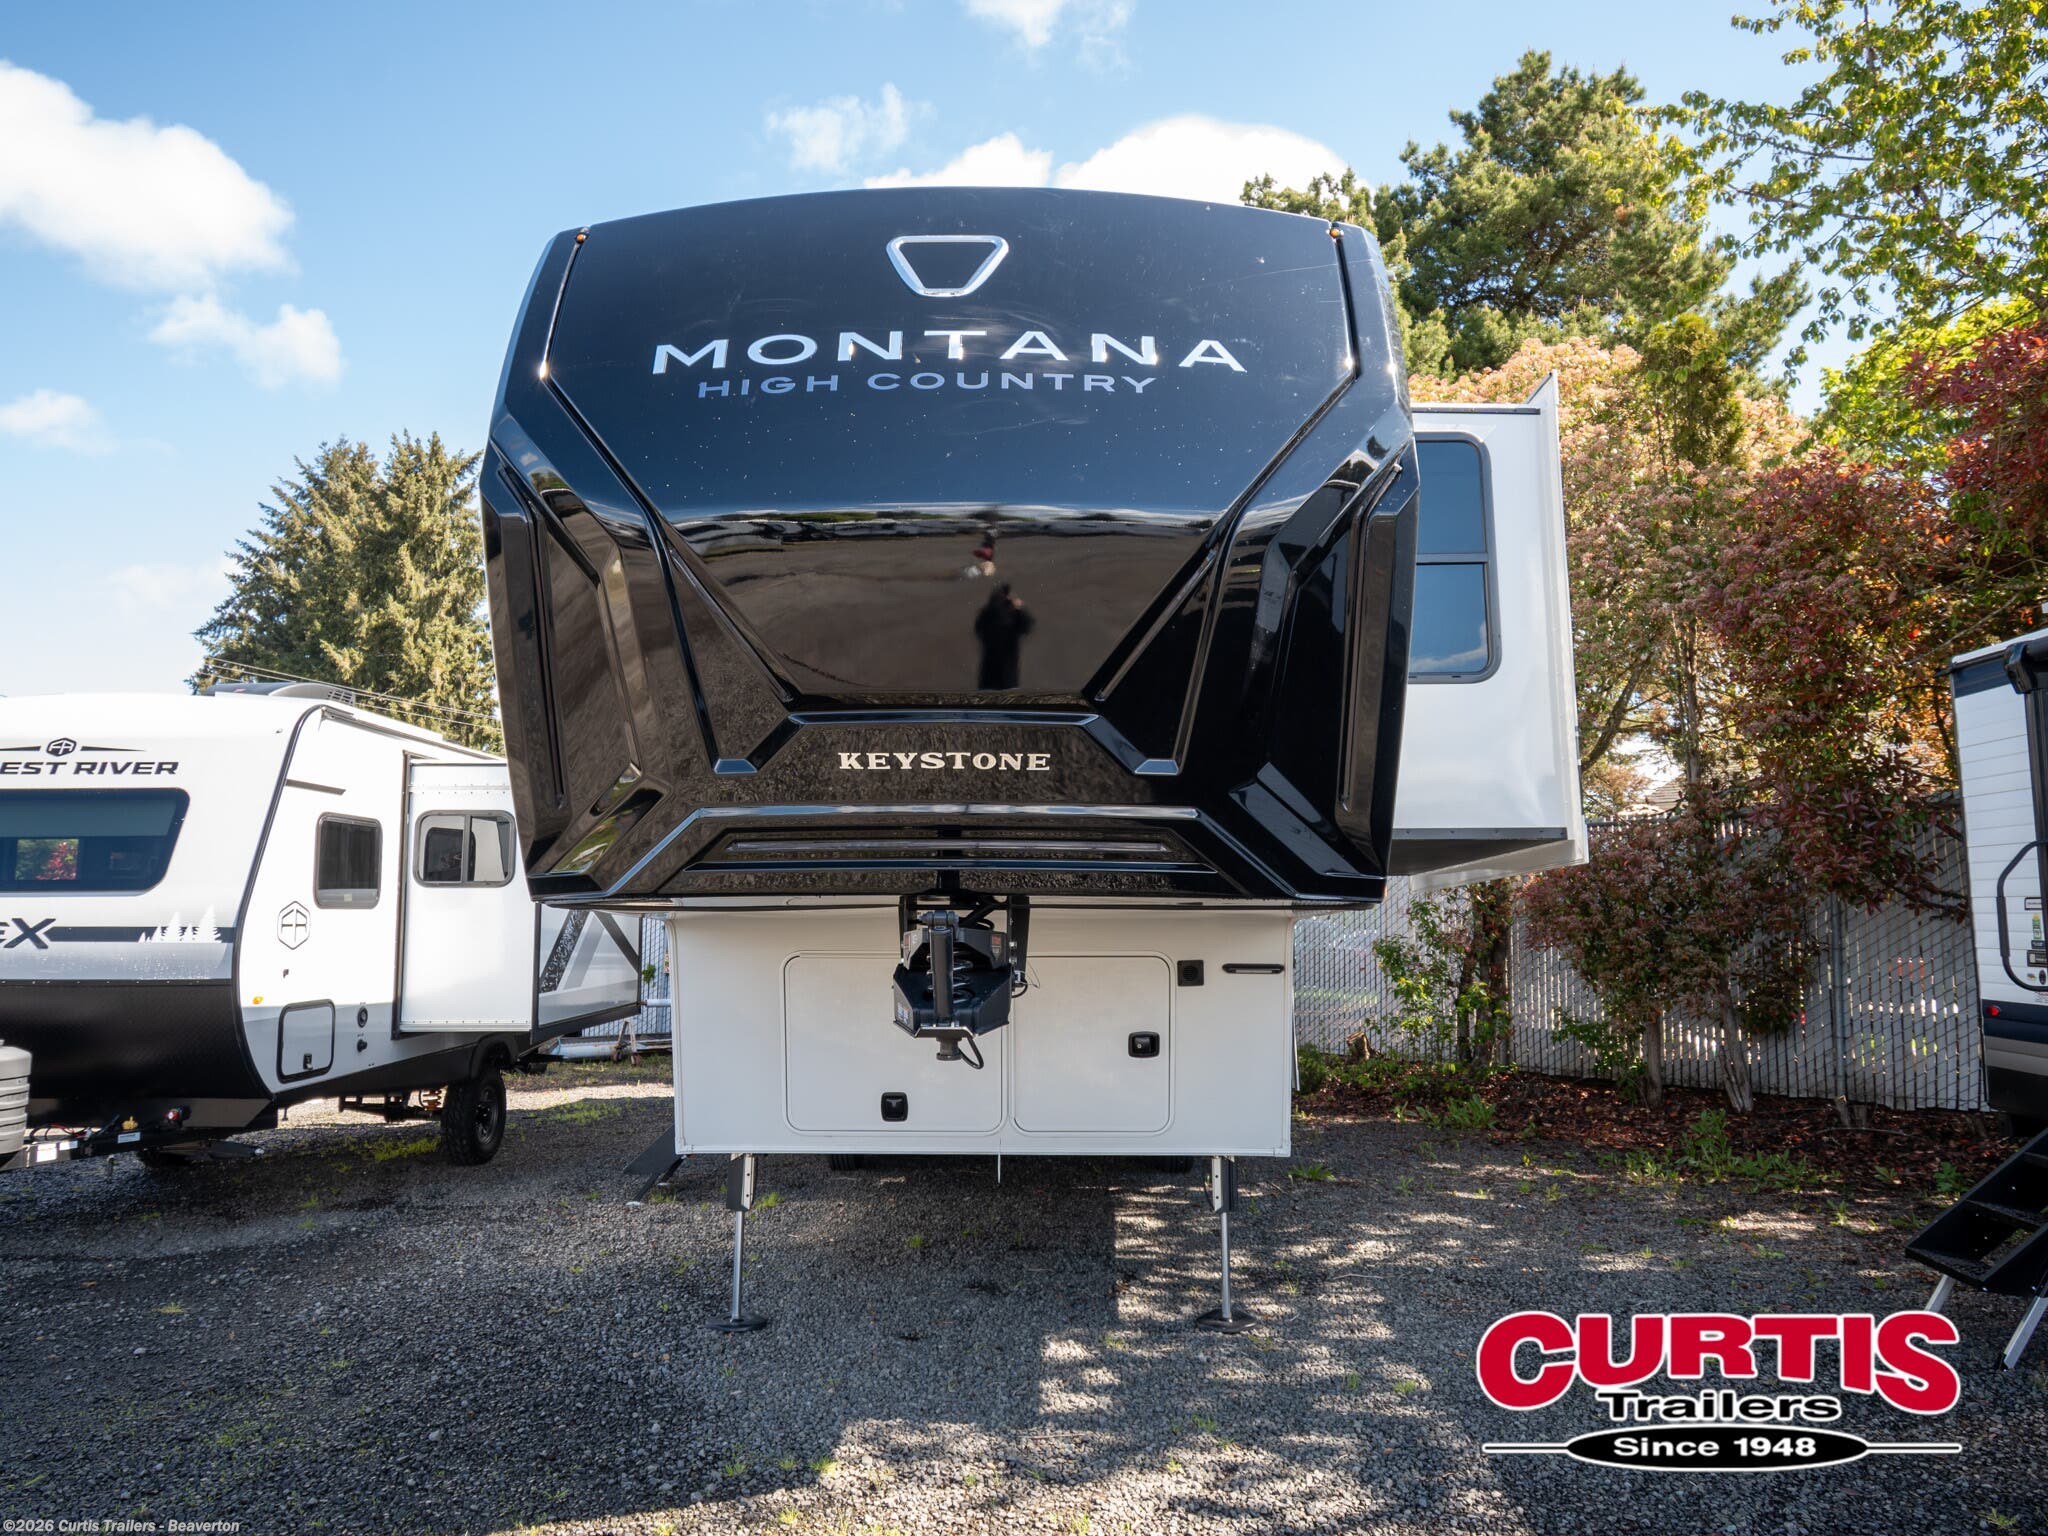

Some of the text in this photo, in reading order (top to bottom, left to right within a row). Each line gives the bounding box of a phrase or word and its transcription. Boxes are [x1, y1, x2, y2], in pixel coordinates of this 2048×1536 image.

[652, 330, 1247, 374] MONTANA
[698, 371, 1156, 398] HIGH COUNTRY
[73, 761, 179, 775] RIVER
[838, 752, 1051, 771] KEYSTONE
